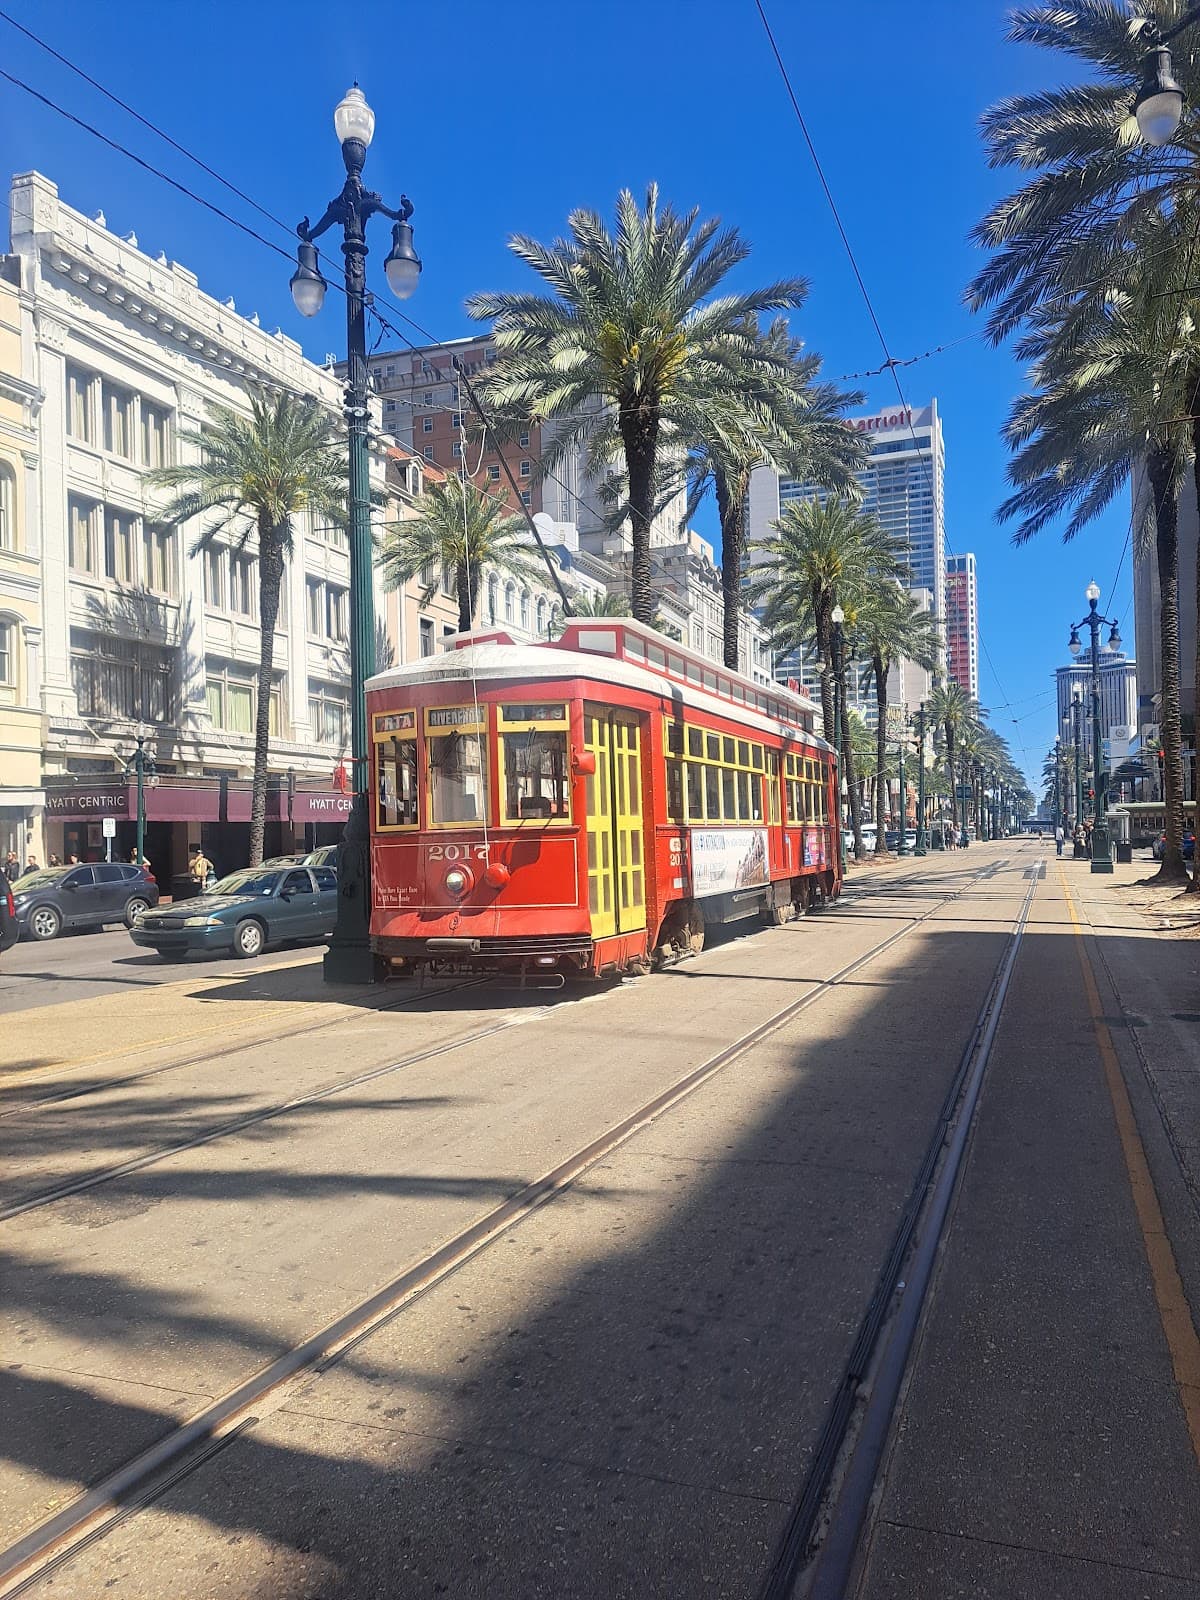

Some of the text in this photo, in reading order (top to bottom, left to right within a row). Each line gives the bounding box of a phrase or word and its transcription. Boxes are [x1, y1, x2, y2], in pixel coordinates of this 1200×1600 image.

[45, 796, 125, 808] HYATT CENTRIC
[309, 798, 335, 810] HYATT
[429, 844, 491, 860] 2017
